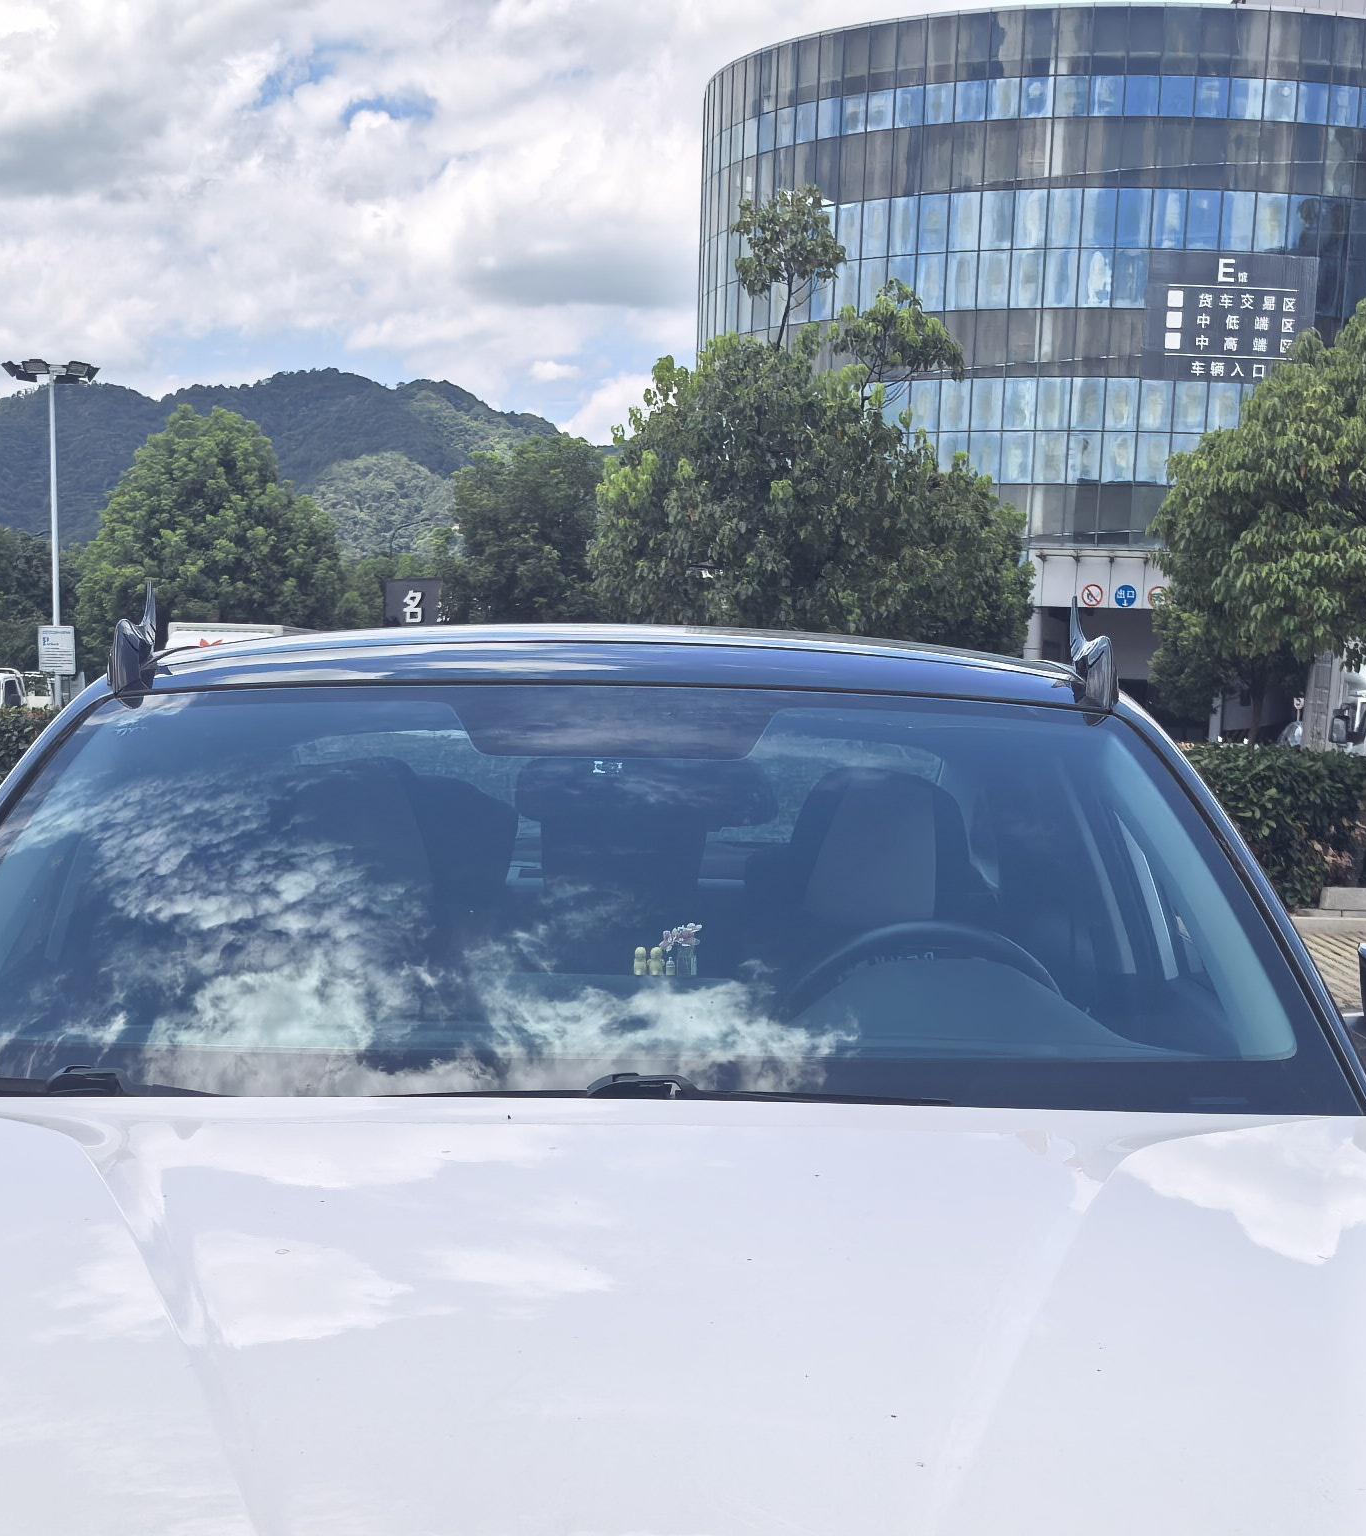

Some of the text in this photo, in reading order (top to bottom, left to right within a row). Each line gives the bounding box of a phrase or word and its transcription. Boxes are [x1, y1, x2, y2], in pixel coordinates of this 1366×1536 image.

[1198, 293, 1296, 312] 货车交易区
[1196, 313, 1295, 333] 中低端区
[1191, 360, 1266, 378] 车辆入口
[402, 589, 423, 623] 名
